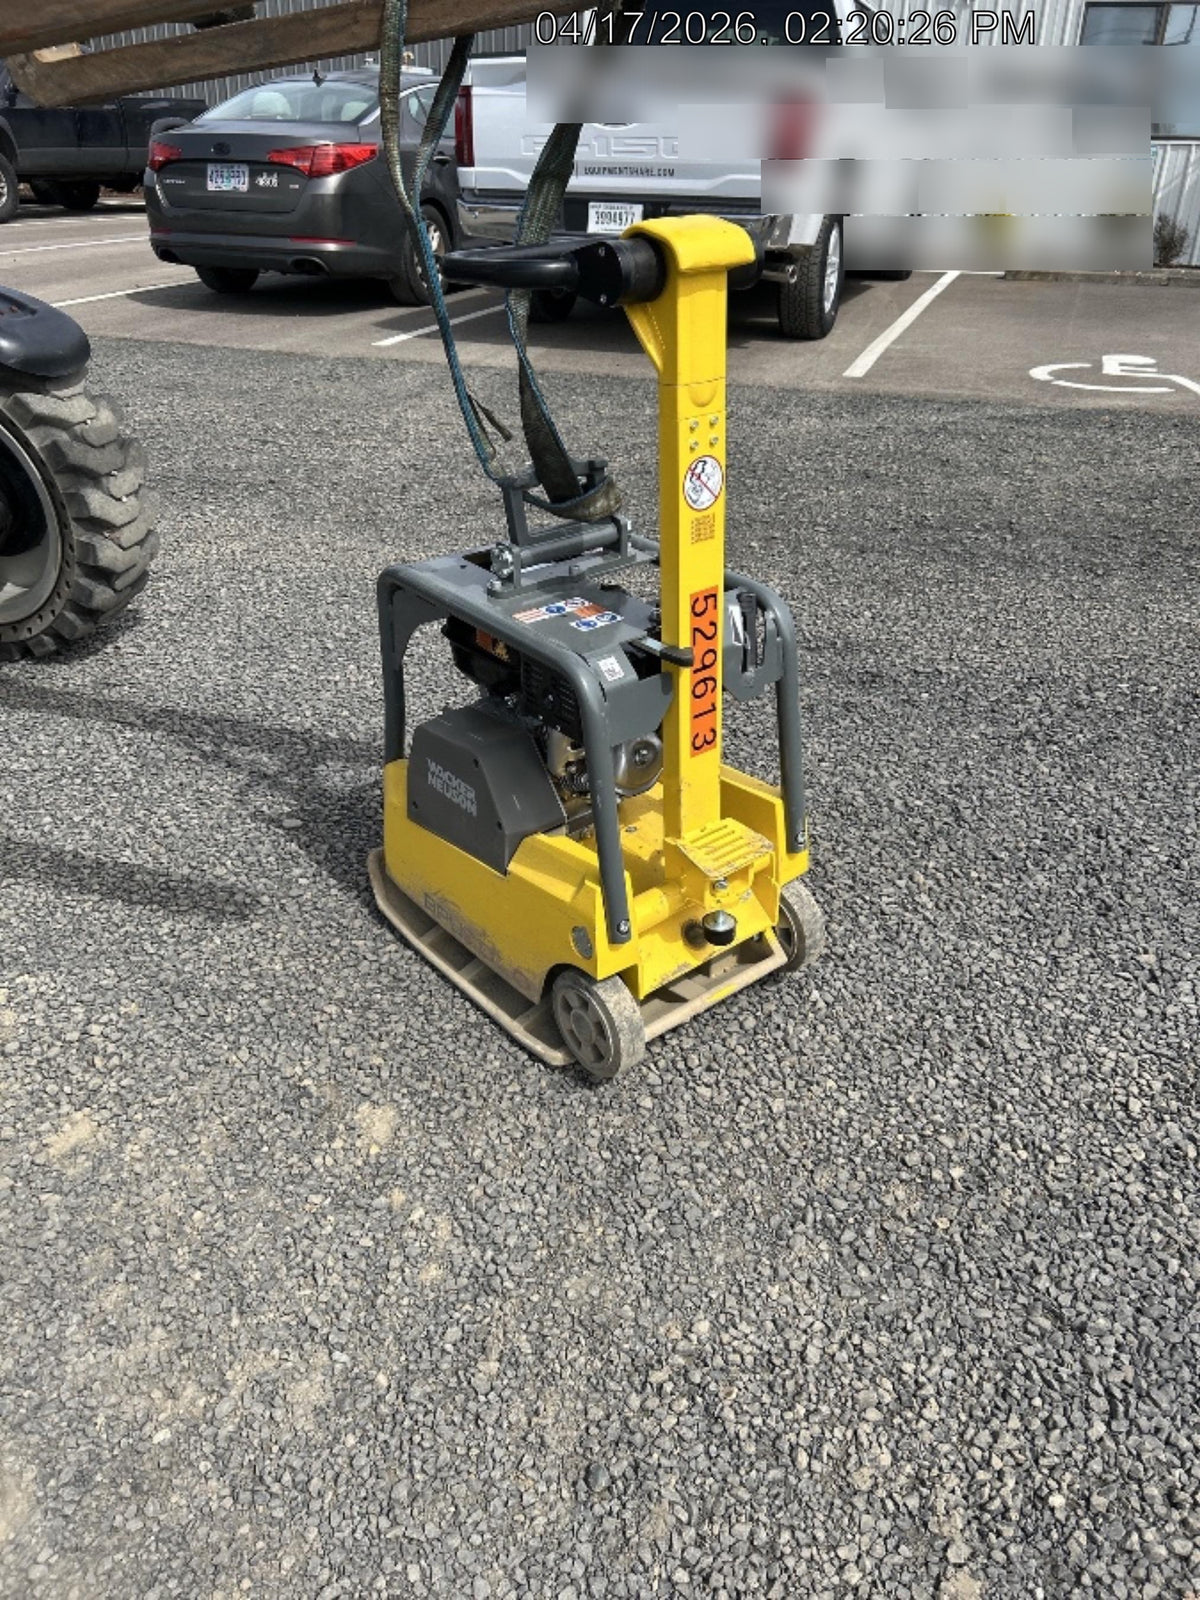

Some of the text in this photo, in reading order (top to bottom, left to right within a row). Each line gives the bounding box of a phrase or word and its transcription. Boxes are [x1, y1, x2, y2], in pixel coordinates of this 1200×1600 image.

[690, 593, 718, 751] 529613
[425, 757, 476, 802] WACKER
[427, 771, 477, 817] NEUSON
